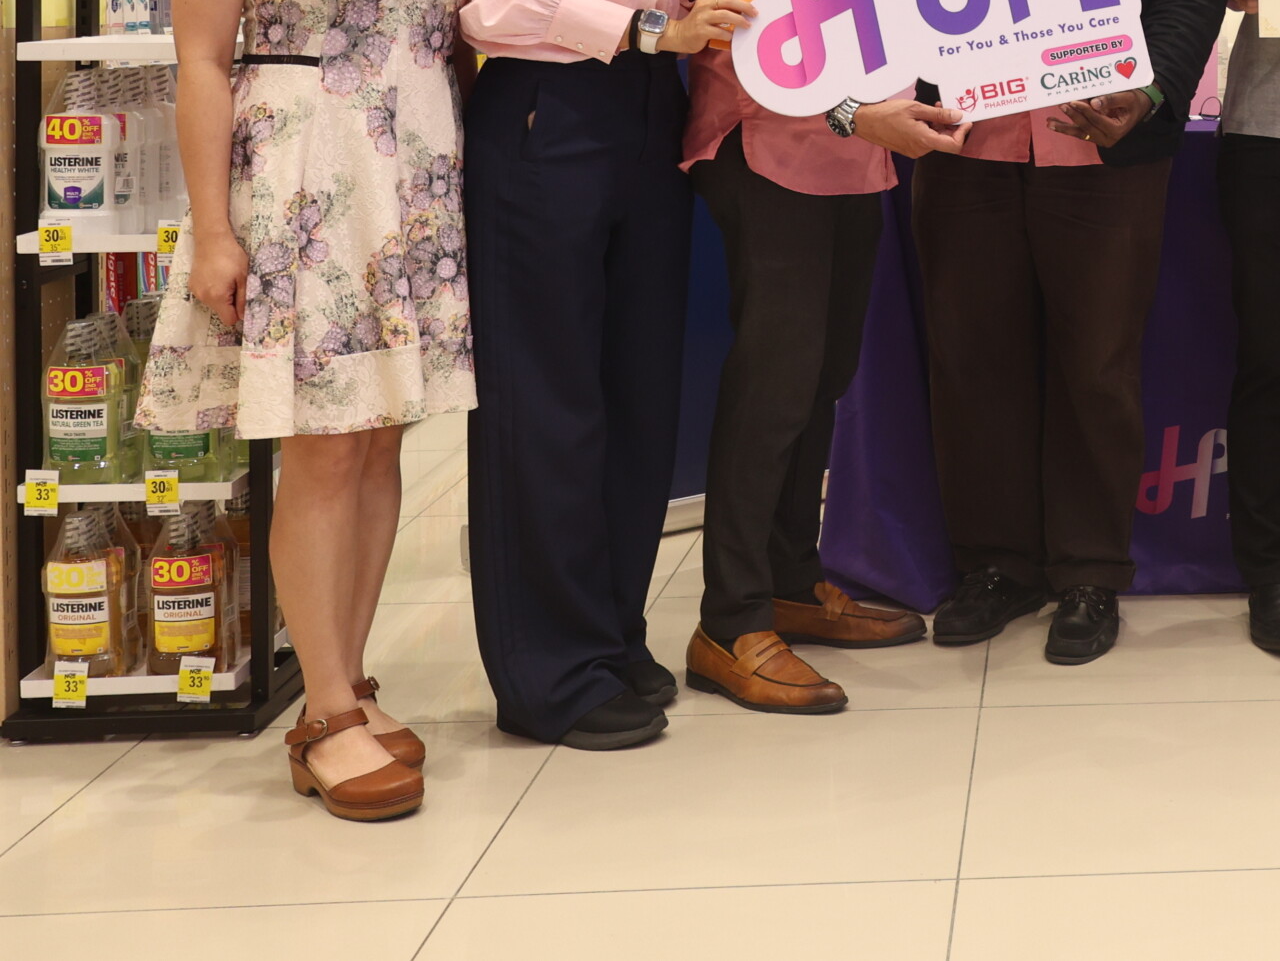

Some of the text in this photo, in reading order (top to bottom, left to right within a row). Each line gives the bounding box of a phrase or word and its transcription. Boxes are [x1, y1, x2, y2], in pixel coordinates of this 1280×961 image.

[938, 16, 1120, 57] For You & Those You Care
[1050, 39, 1124, 61] SUPPORTED BY
[980, 77, 1026, 100] BIG
[1047, 80, 1113, 97] PHARMACY
[984, 95, 1028, 110] PHARMACY
[47, 118, 82, 140] 40
[50, 157, 101, 167] LISTERINE
[44, 229, 59, 242] 30
[163, 230, 178, 243] 30
[49, 370, 83, 392] 30
[51, 408, 104, 419] LISTERINE
[151, 481, 165, 494] 30
[36, 488, 50, 501] 33
[153, 561, 190, 583] 30
[52, 601, 105, 614] LISTERINE
[157, 597, 212, 610] LISTERINE
[58, 614, 97, 622] ORIGINAL
[163, 610, 203, 619] ORIGINAL
[64, 680, 78, 693] 33
[189, 675, 203, 688] 33
